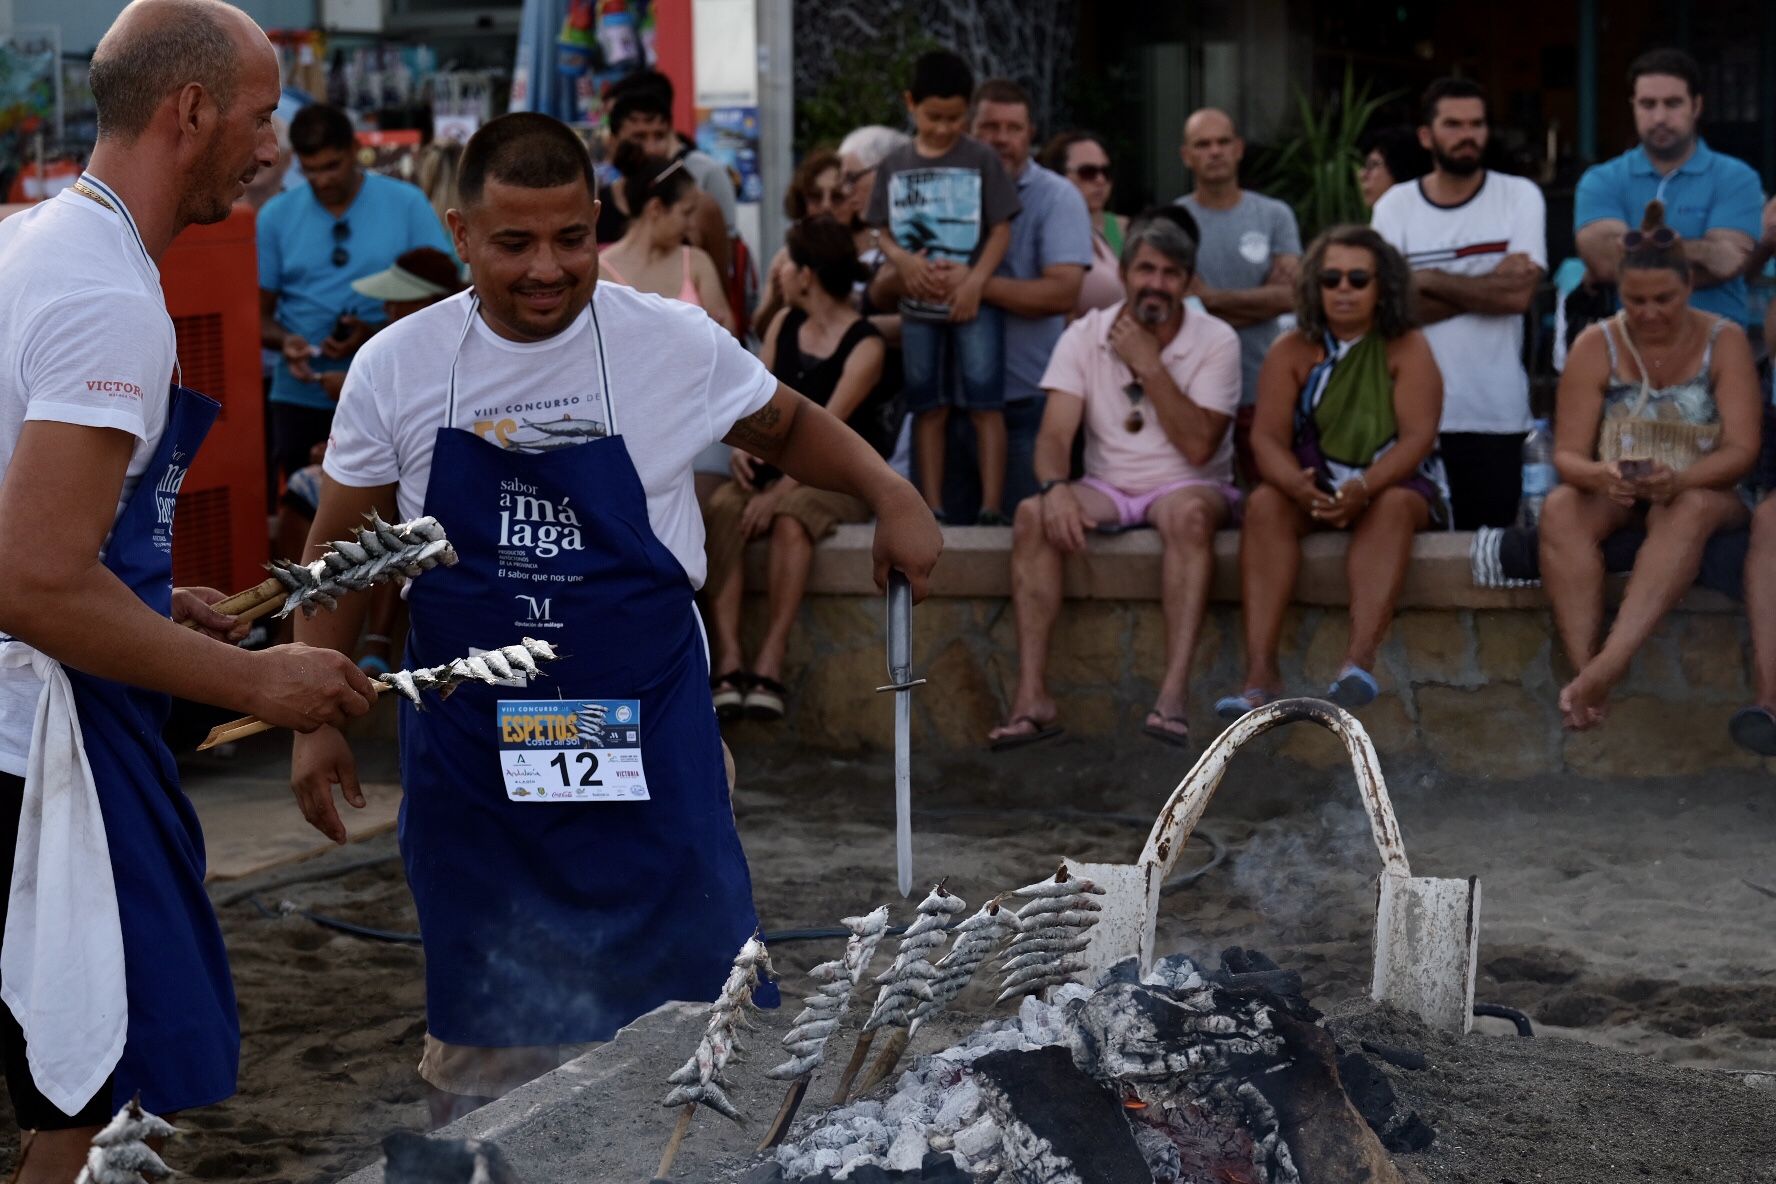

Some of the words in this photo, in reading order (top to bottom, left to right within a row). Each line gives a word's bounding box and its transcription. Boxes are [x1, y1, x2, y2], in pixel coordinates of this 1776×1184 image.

[474, 408, 499, 417] VIII
[505, 396, 580, 413] CONCURSO
[586, 393, 601, 402] DE
[500, 478, 539, 495] sabor
[498, 510, 586, 558] laga
[498, 569, 506, 577] El
[507, 571, 530, 580] sabor
[531, 573, 548, 582] que
[502, 714, 578, 743] ESPETOS
[525, 737, 552, 746] Costa
[566, 737, 580, 746] Sol
[550, 751, 603, 787] 12
